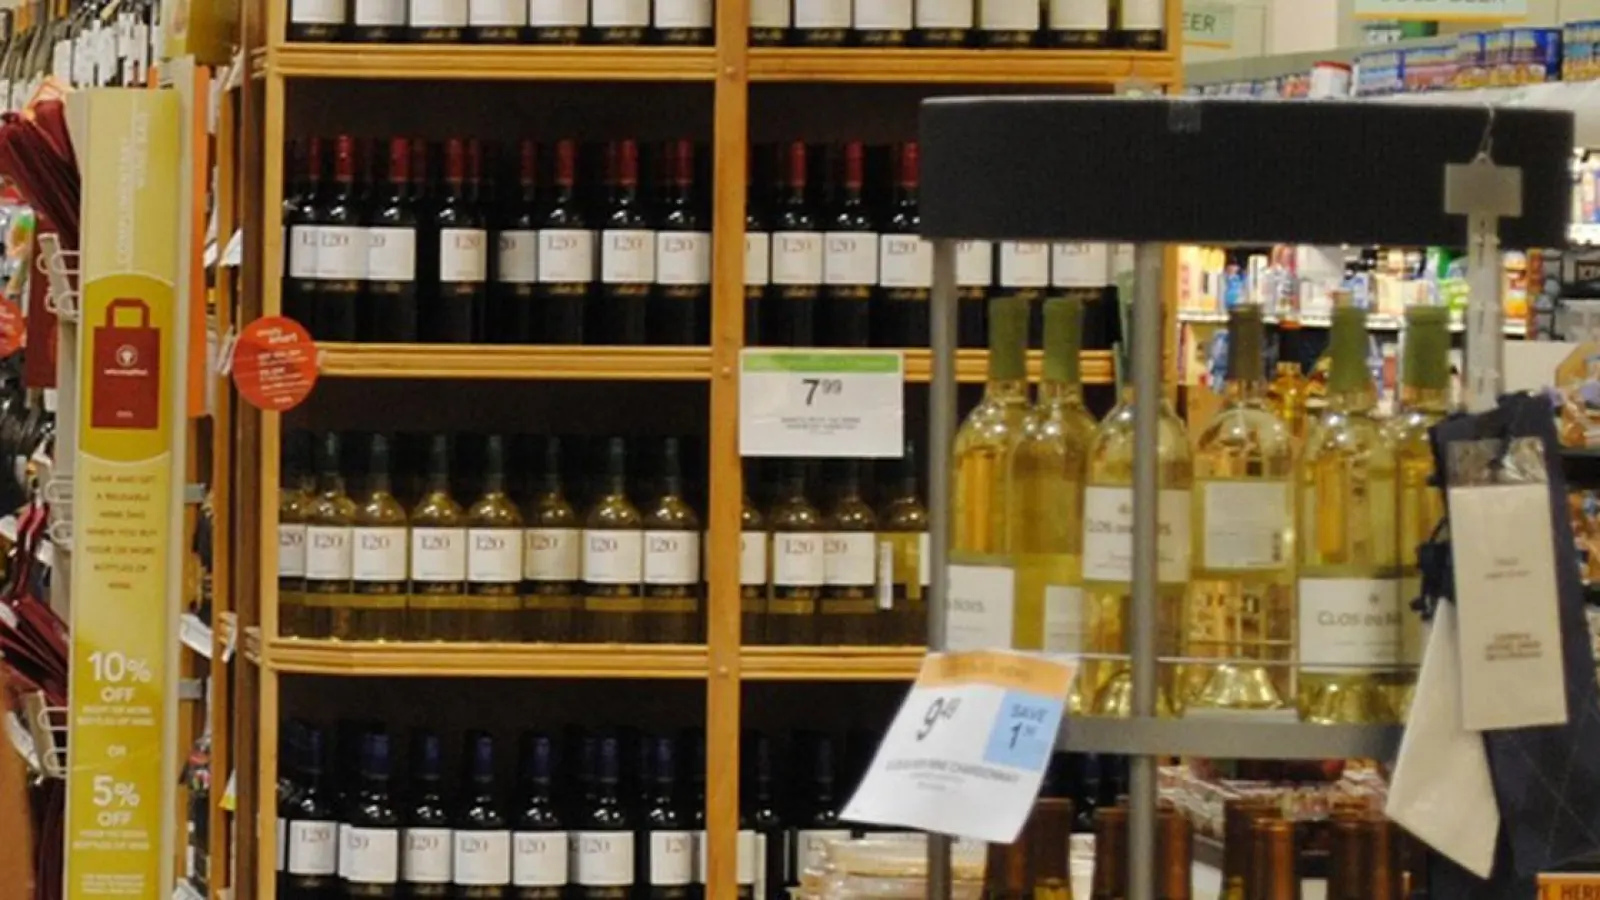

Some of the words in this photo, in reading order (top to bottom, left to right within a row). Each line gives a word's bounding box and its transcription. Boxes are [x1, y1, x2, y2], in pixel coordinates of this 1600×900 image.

[1181, 12, 1216, 33] EER
[321, 232, 349, 248] 120
[456, 234, 481, 250] 120
[550, 236, 578, 250] 120
[614, 236, 644, 252] 120
[664, 238, 694, 254] 120
[782, 237, 812, 252] 120
[829, 238, 857, 254] 120
[888, 240, 917, 256] 120
[313, 532, 344, 549] 120
[360, 534, 390, 550] 120
[421, 534, 451, 550] 120
[476, 534, 504, 550] 120
[529, 534, 558, 550] 120
[590, 536, 618, 552] 120
[650, 536, 679, 552] 120
[785, 539, 814, 554] 120
[1317, 610, 1360, 626] CLOS
[88, 651, 152, 682] 10%
[101, 687, 136, 703] OFF
[1010, 704, 1049, 726] SAVE
[108, 744, 127, 758] OR
[93, 775, 140, 808] 5%
[98, 810, 132, 827] OFF
[300, 828, 330, 844] 120
[408, 834, 439, 850] 120
[462, 836, 490, 853] 120
